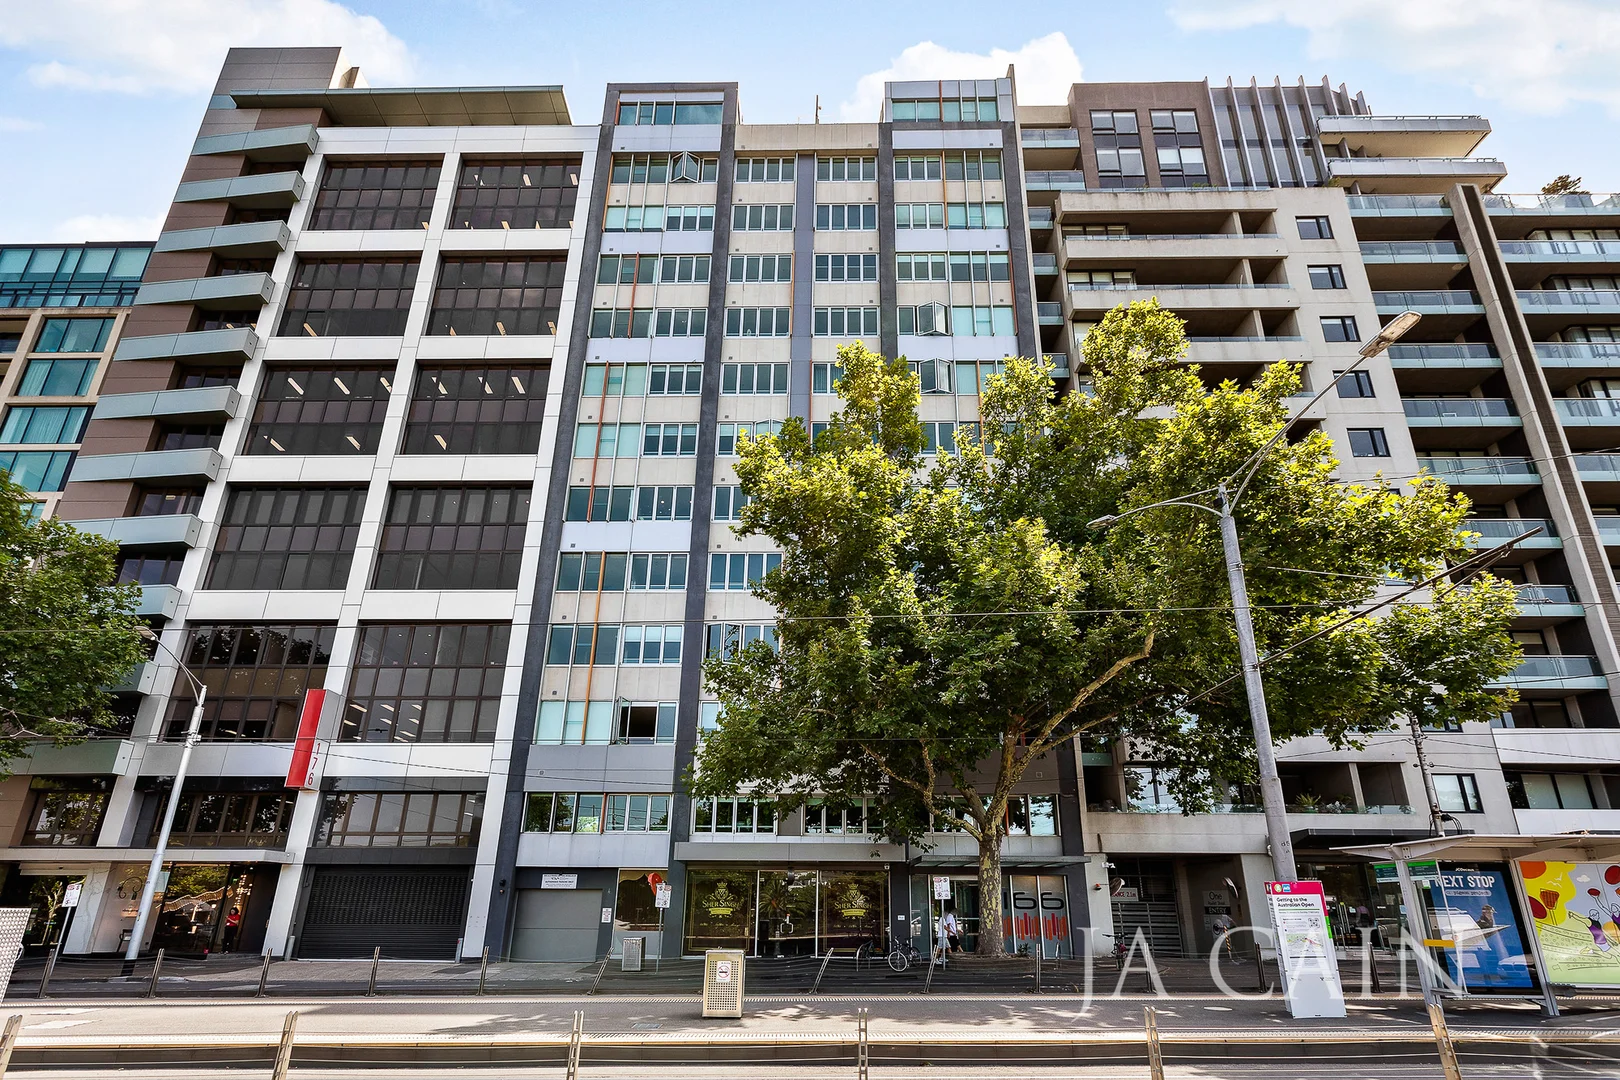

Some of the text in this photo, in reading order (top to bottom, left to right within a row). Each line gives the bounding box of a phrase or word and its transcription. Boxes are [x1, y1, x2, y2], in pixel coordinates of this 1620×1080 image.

[307, 742, 321, 785] 176
[1435, 875, 1496, 888] NEXT STOP
[1003, 891, 1065, 910] 166
